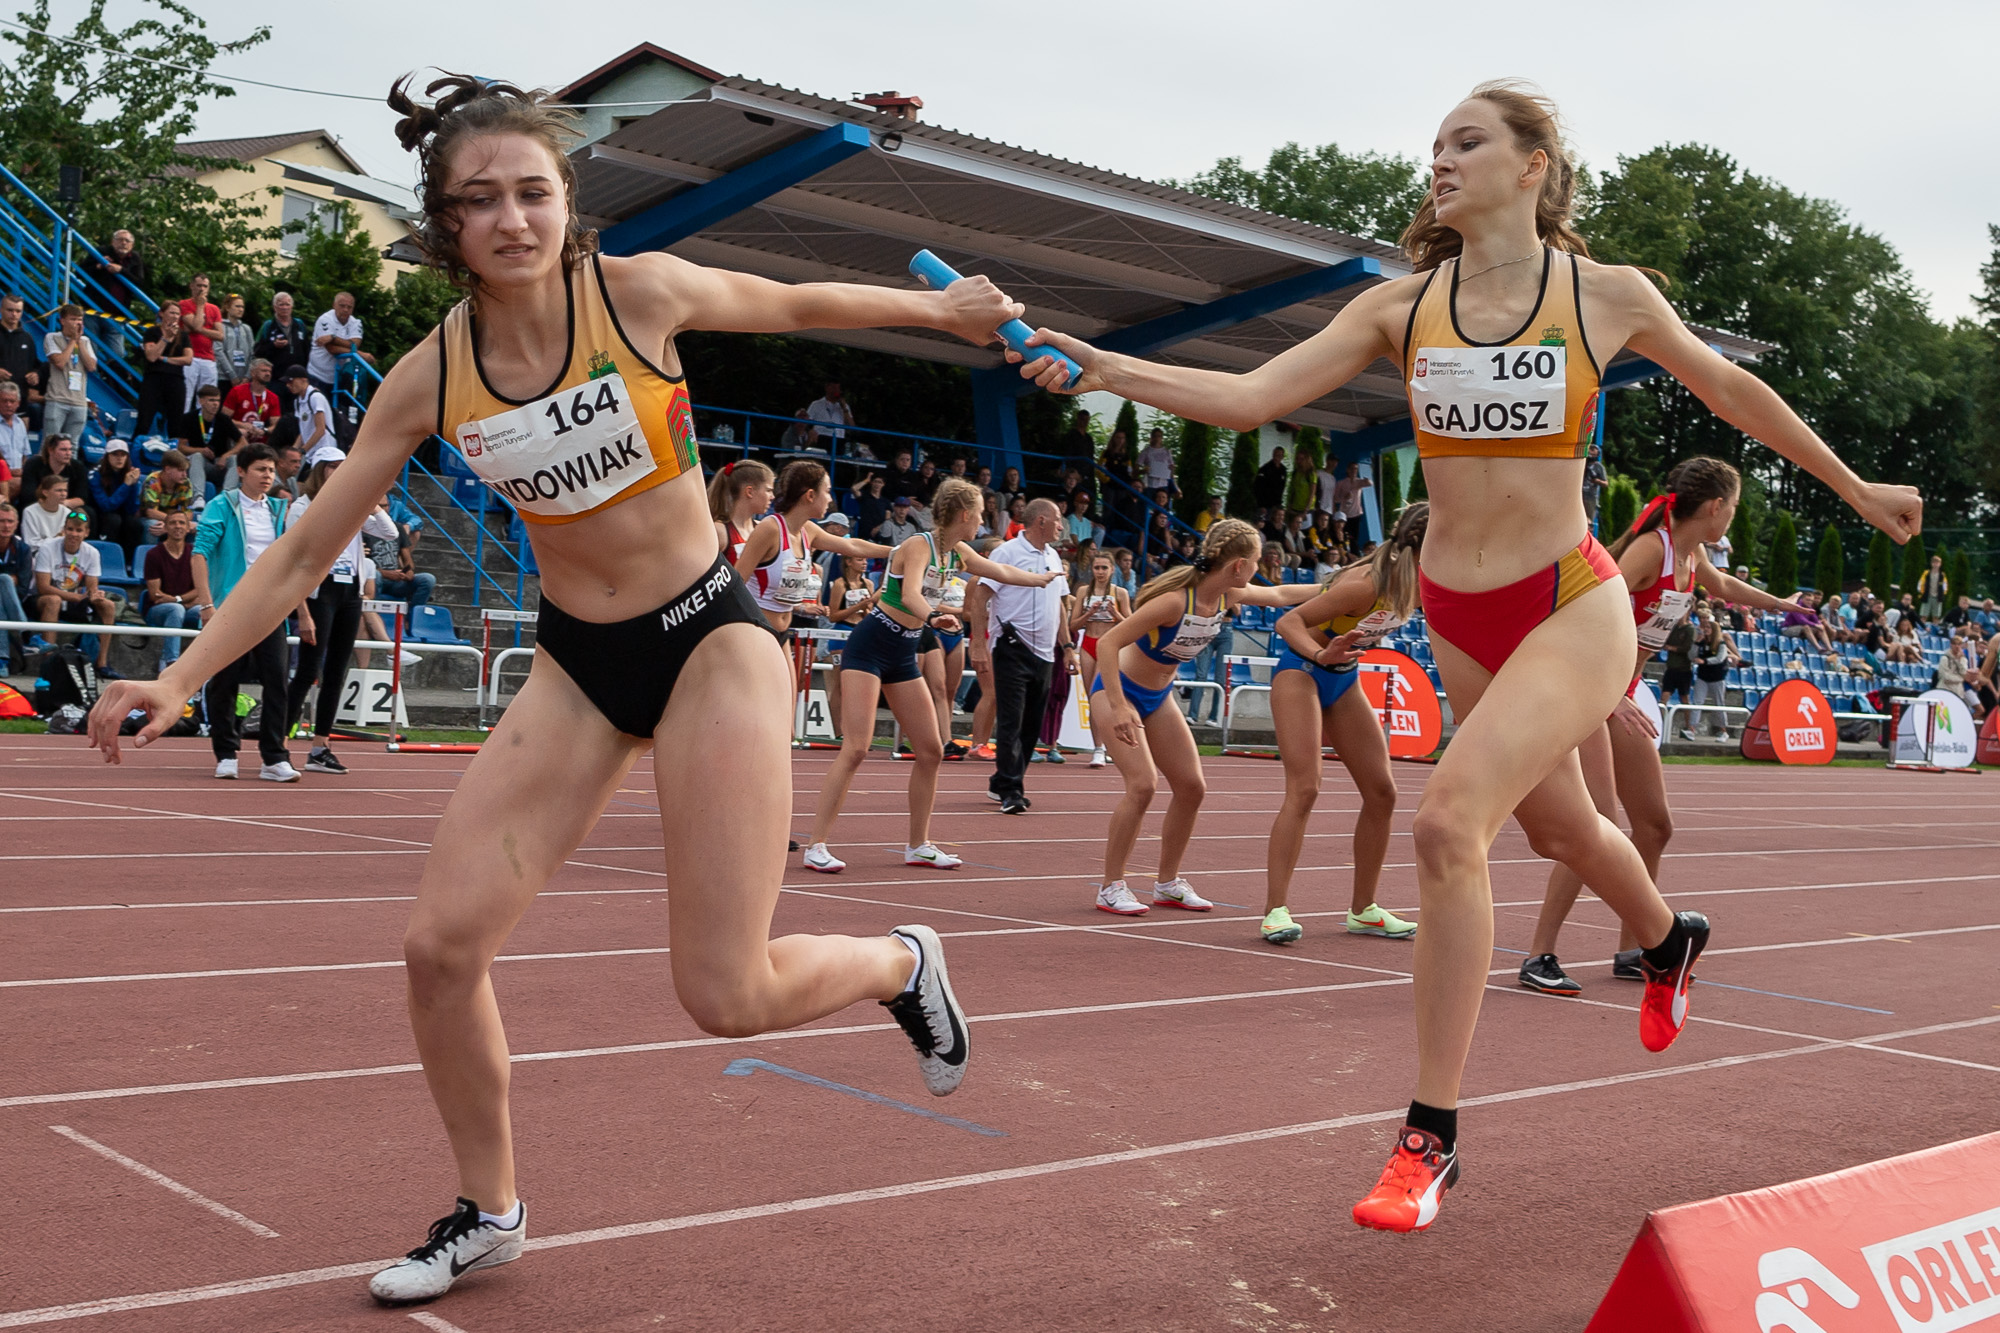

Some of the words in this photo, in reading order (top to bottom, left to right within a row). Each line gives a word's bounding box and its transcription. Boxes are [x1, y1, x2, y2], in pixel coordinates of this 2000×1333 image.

[1491, 351, 1556, 381] 160
[545, 382, 620, 436] 164
[1425, 401, 1549, 432] GAJOSZ
[661, 589, 707, 631] NIKE
[705, 564, 732, 600] PRO
[343, 680, 360, 711] 2
[372, 682, 394, 713] 2
[807, 701, 825, 726] 4
[1788, 731, 1821, 747] ORLEN
